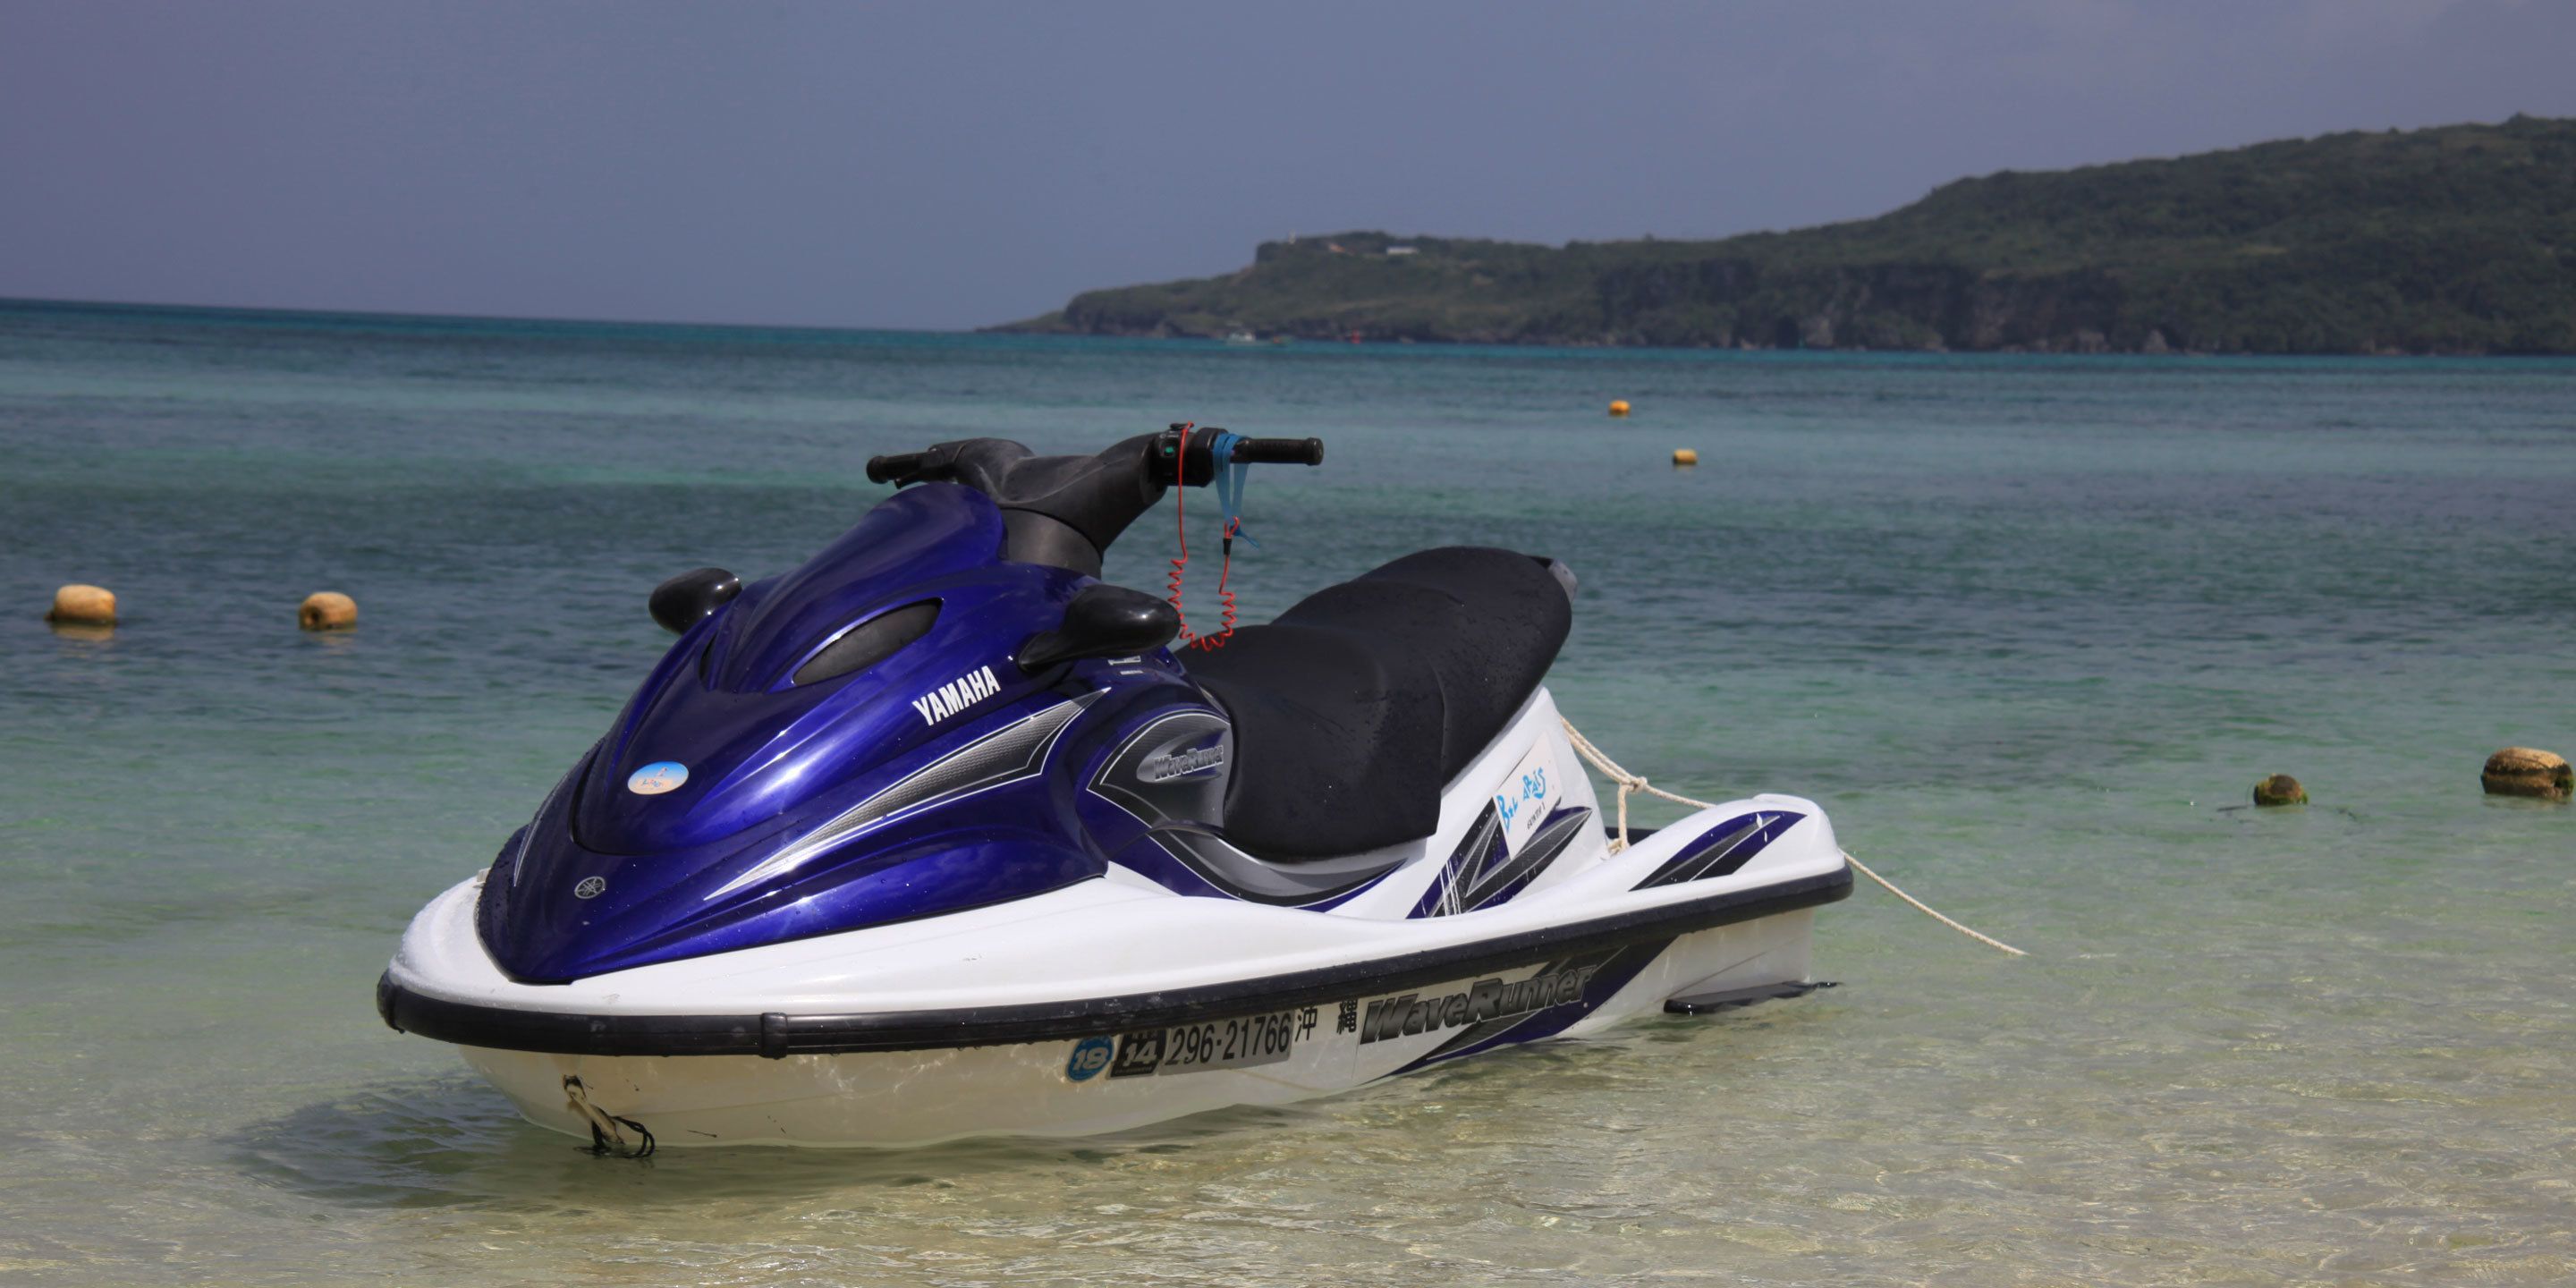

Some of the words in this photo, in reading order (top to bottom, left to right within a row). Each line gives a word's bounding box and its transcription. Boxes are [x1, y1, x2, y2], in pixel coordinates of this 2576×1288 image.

[911, 665, 1001, 725] YAMAHA
[1359, 964, 1597, 1045] WaveRunner
[1123, 1040, 1157, 1067] 14
